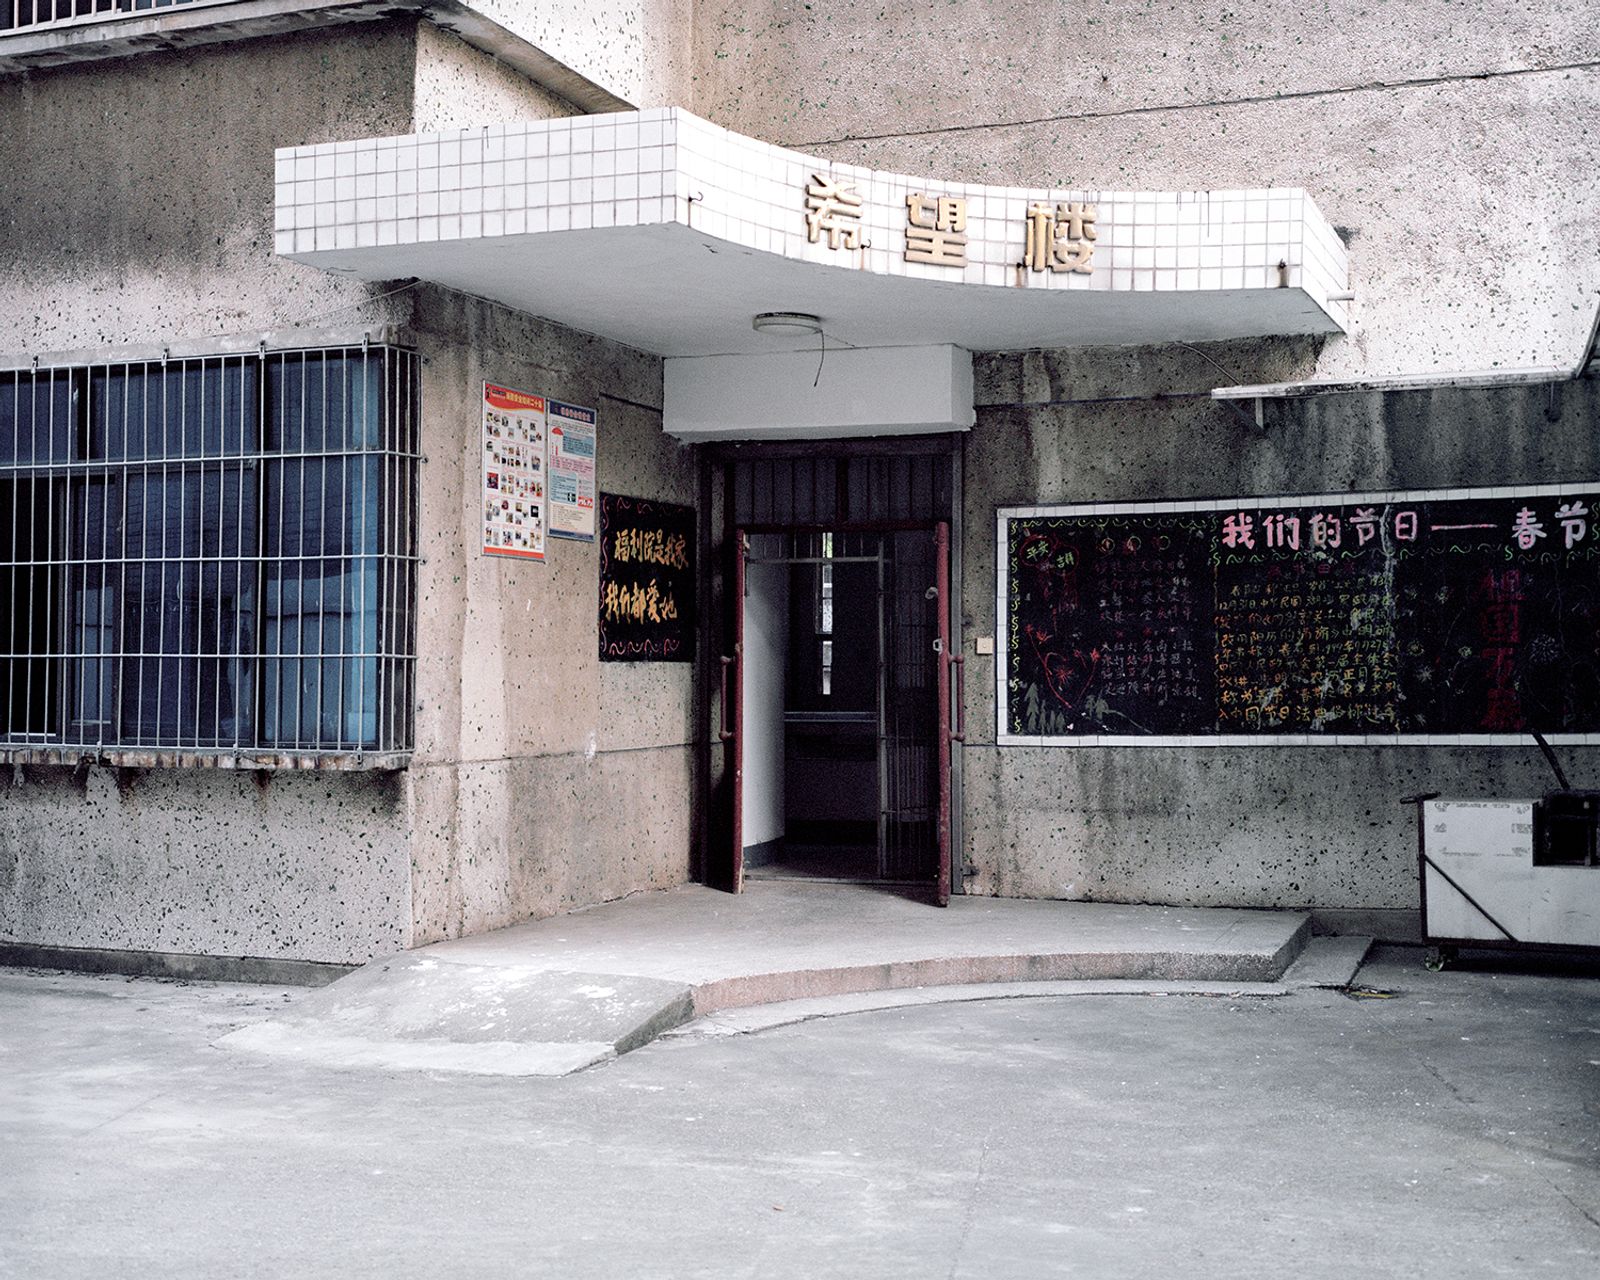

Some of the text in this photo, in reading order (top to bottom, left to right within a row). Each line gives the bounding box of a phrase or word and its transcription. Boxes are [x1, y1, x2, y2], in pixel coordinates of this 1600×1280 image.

[805, 172, 1097, 274] 希望楼
[614, 528, 689, 570] 福利院是我家
